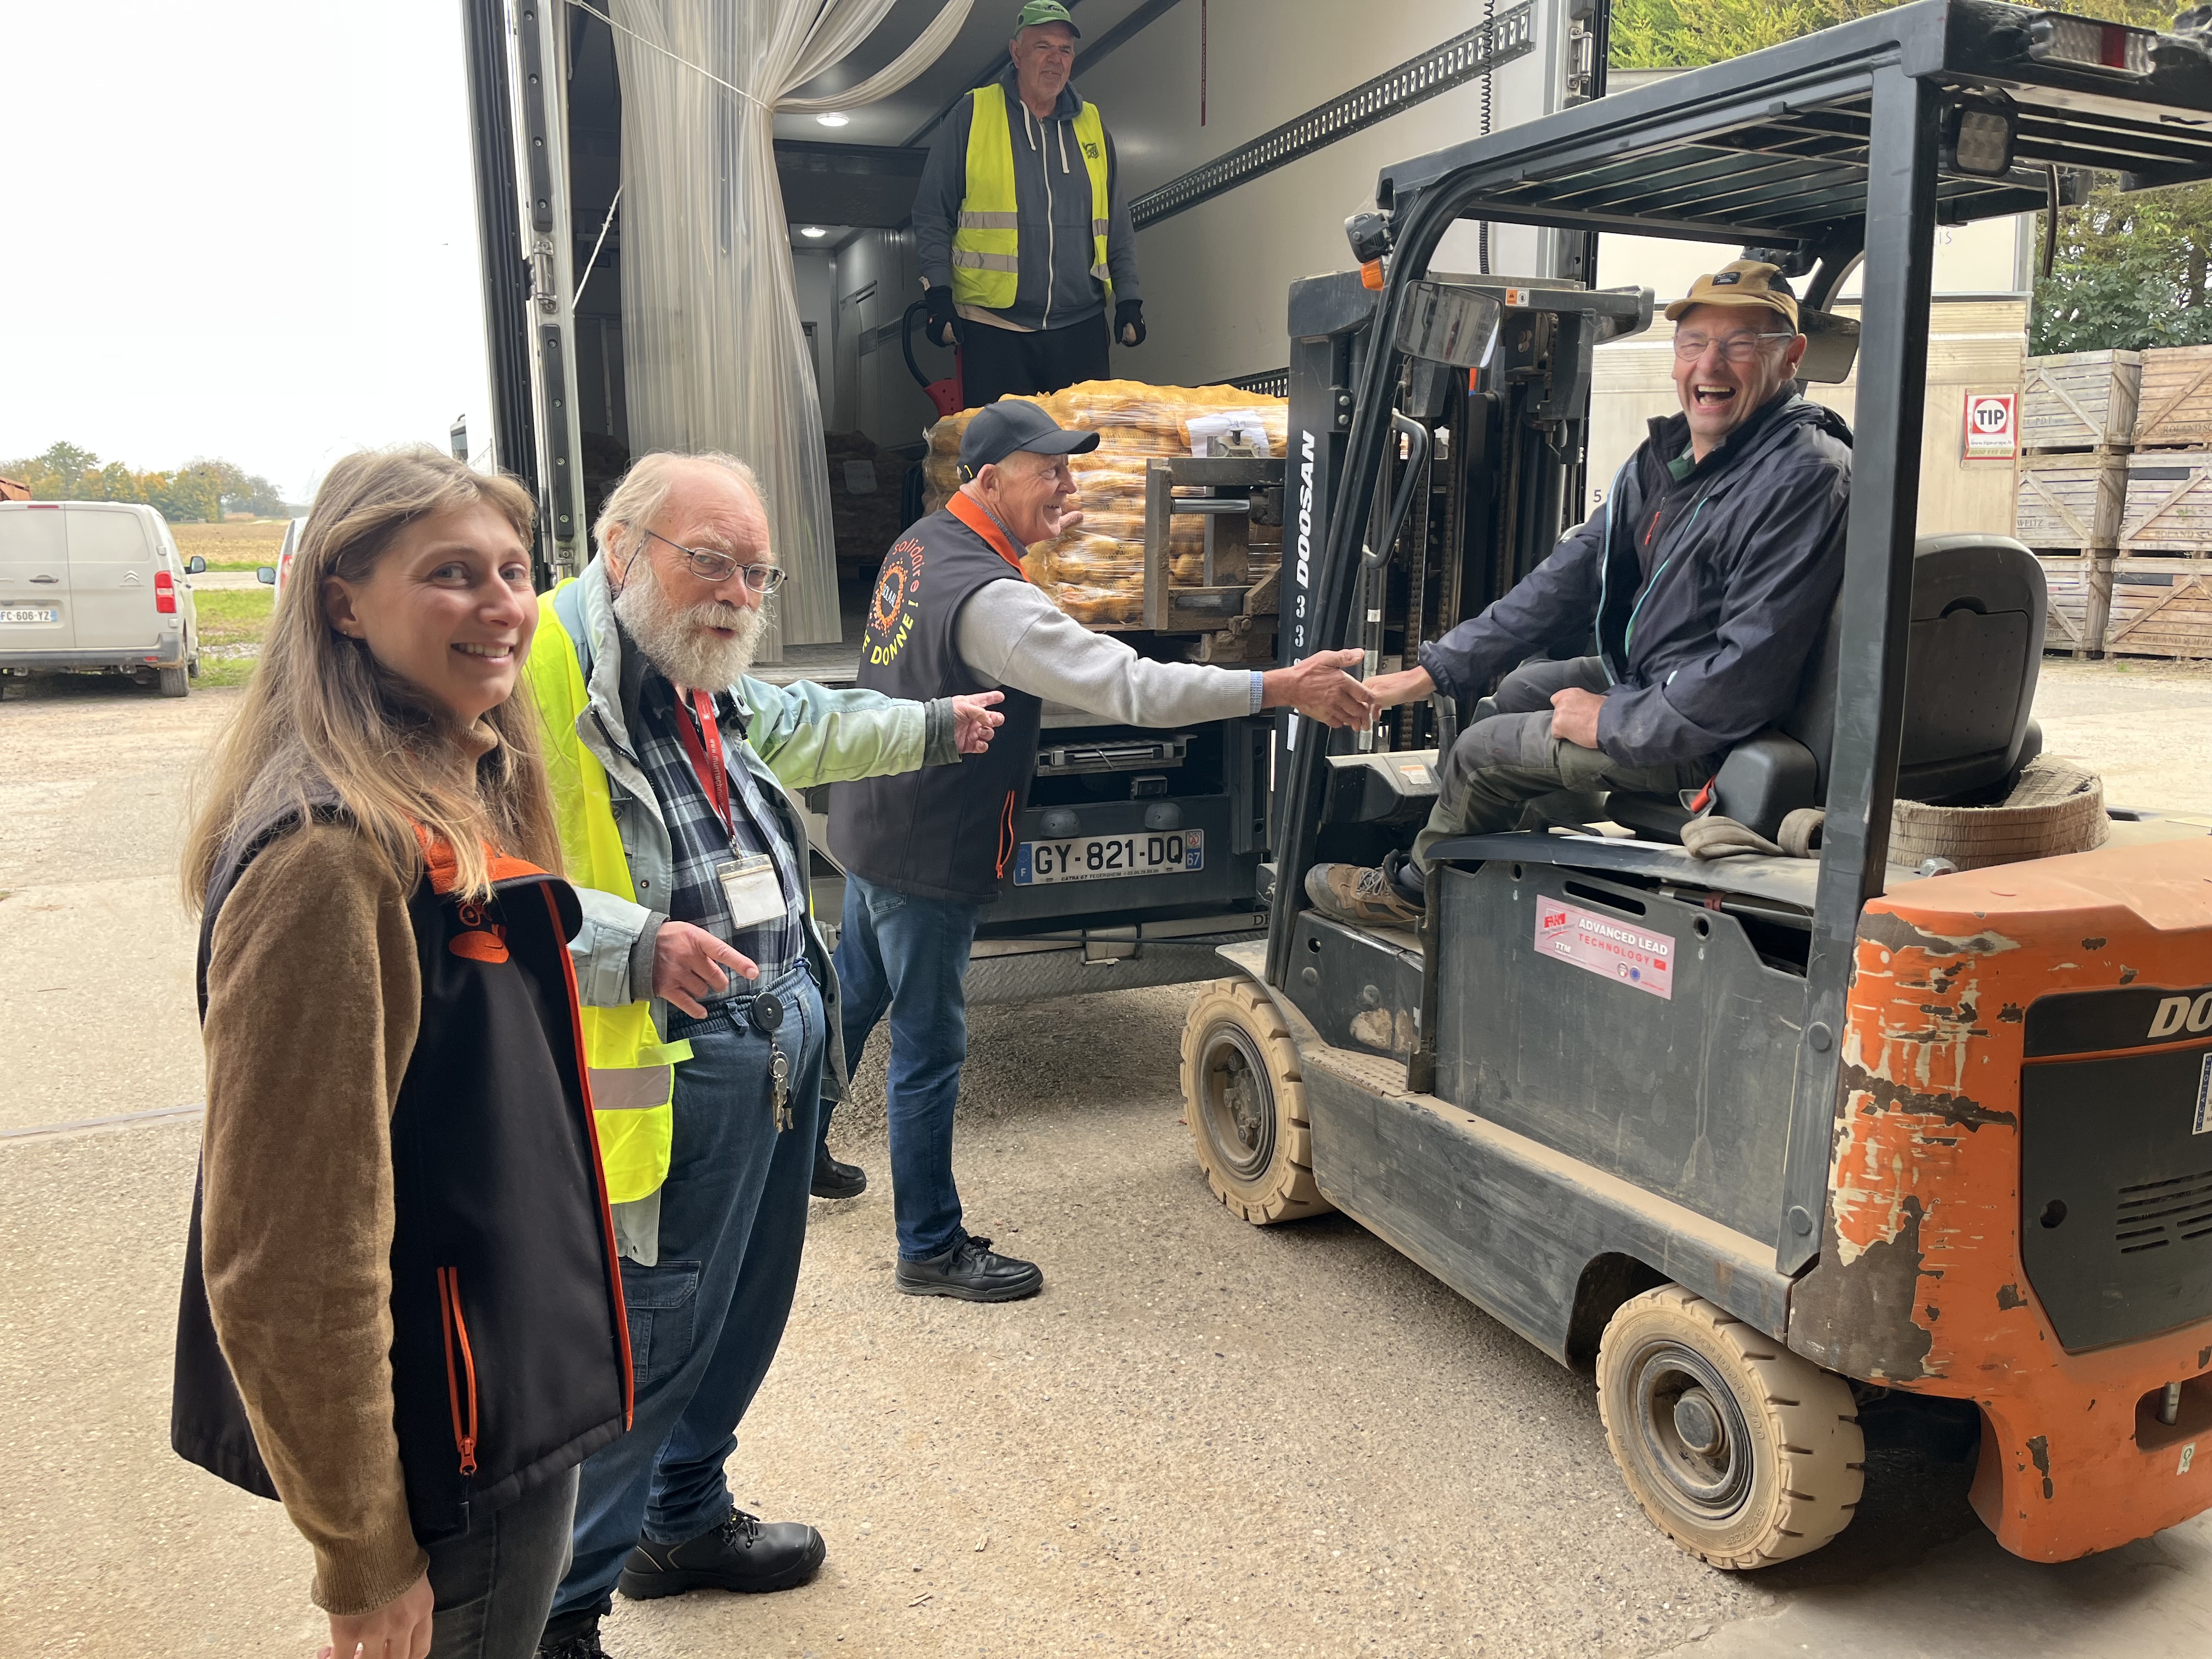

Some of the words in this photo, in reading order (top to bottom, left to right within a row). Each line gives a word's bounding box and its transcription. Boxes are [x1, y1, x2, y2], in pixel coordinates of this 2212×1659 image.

[1977, 409, 2005, 425] TIP
[1296, 430, 1316, 589] DOOSAN
[1593, 489, 1601, 503] 5
[892, 538, 925, 593] solidaire
[1, 611, 50, 621] FC-606-YZ
[870, 613, 914, 665] DONNE
[2183, 636, 2212, 646] SCHW
[1035, 836, 1183, 874] GY-821-DQ
[1187, 851, 1200, 866] 67
[1020, 868, 1026, 877] F
[1555, 941, 1571, 953] TTM
[1578, 918, 1637, 945] ADVANCED
[1638, 937, 1668, 956] LEAD
[1578, 933, 1650, 964] TECHNOLOGY
[2147, 991, 2212, 1039] DO
[2196, 1056, 2212, 1131] LOCATIONS
[1694, 1332, 1750, 1402] SOLIDPRO
[1746, 1407, 1765, 1440] 700
